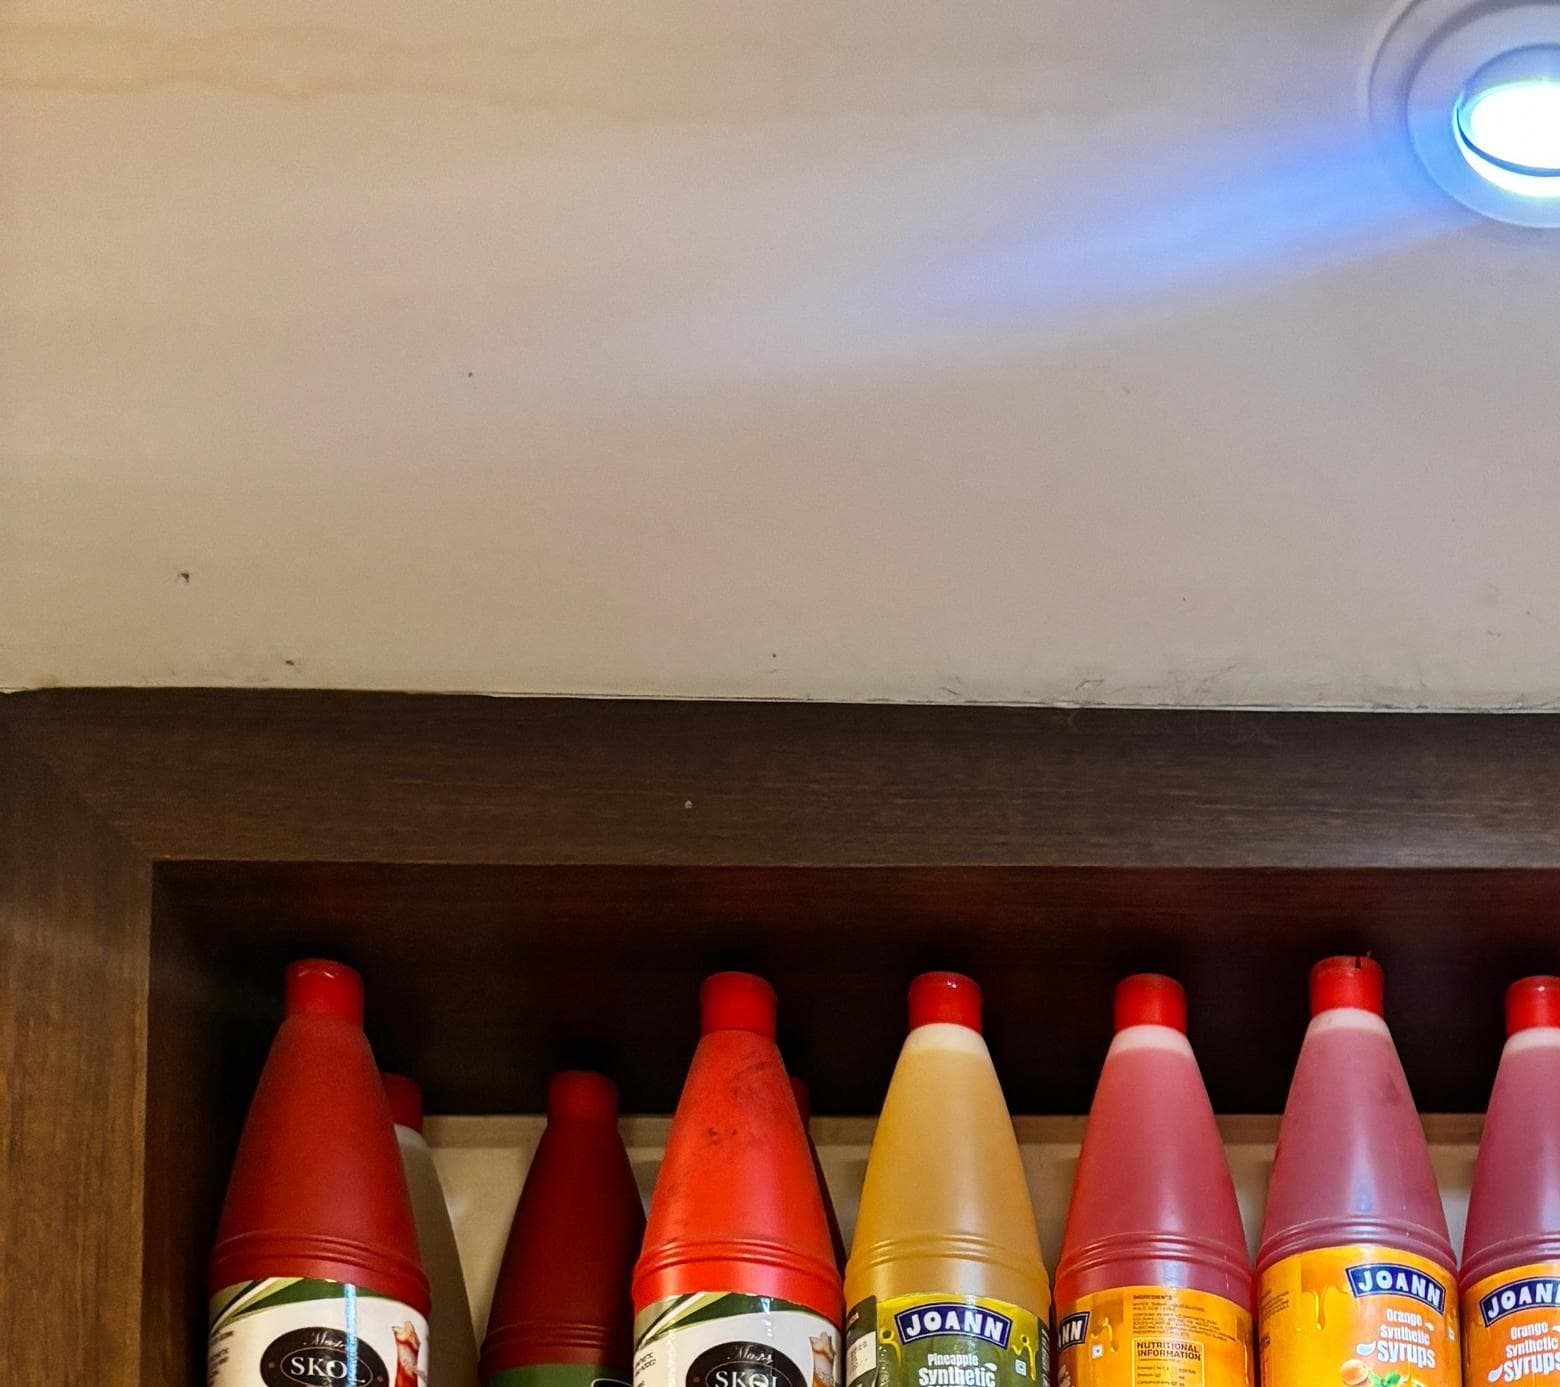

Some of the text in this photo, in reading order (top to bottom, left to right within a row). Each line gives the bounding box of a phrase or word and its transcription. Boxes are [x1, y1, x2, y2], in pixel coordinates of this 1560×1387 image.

[1358, 1269, 1441, 1307] JOANN
[906, 1310, 1003, 1342] JOANN
[1386, 1308, 1423, 1327] Orange
[1510, 1320, 1549, 1340] Orange
[1136, 1341, 1199, 1354] NUTRITIONAL
[1137, 1349, 1201, 1362] INFORMATION
[1505, 1336, 1559, 1359] Synthetic
[291, 1356, 366, 1384] SKOL
[927, 1353, 979, 1367] Pineapple
[918, 1366, 997, 1387] Synthetic
